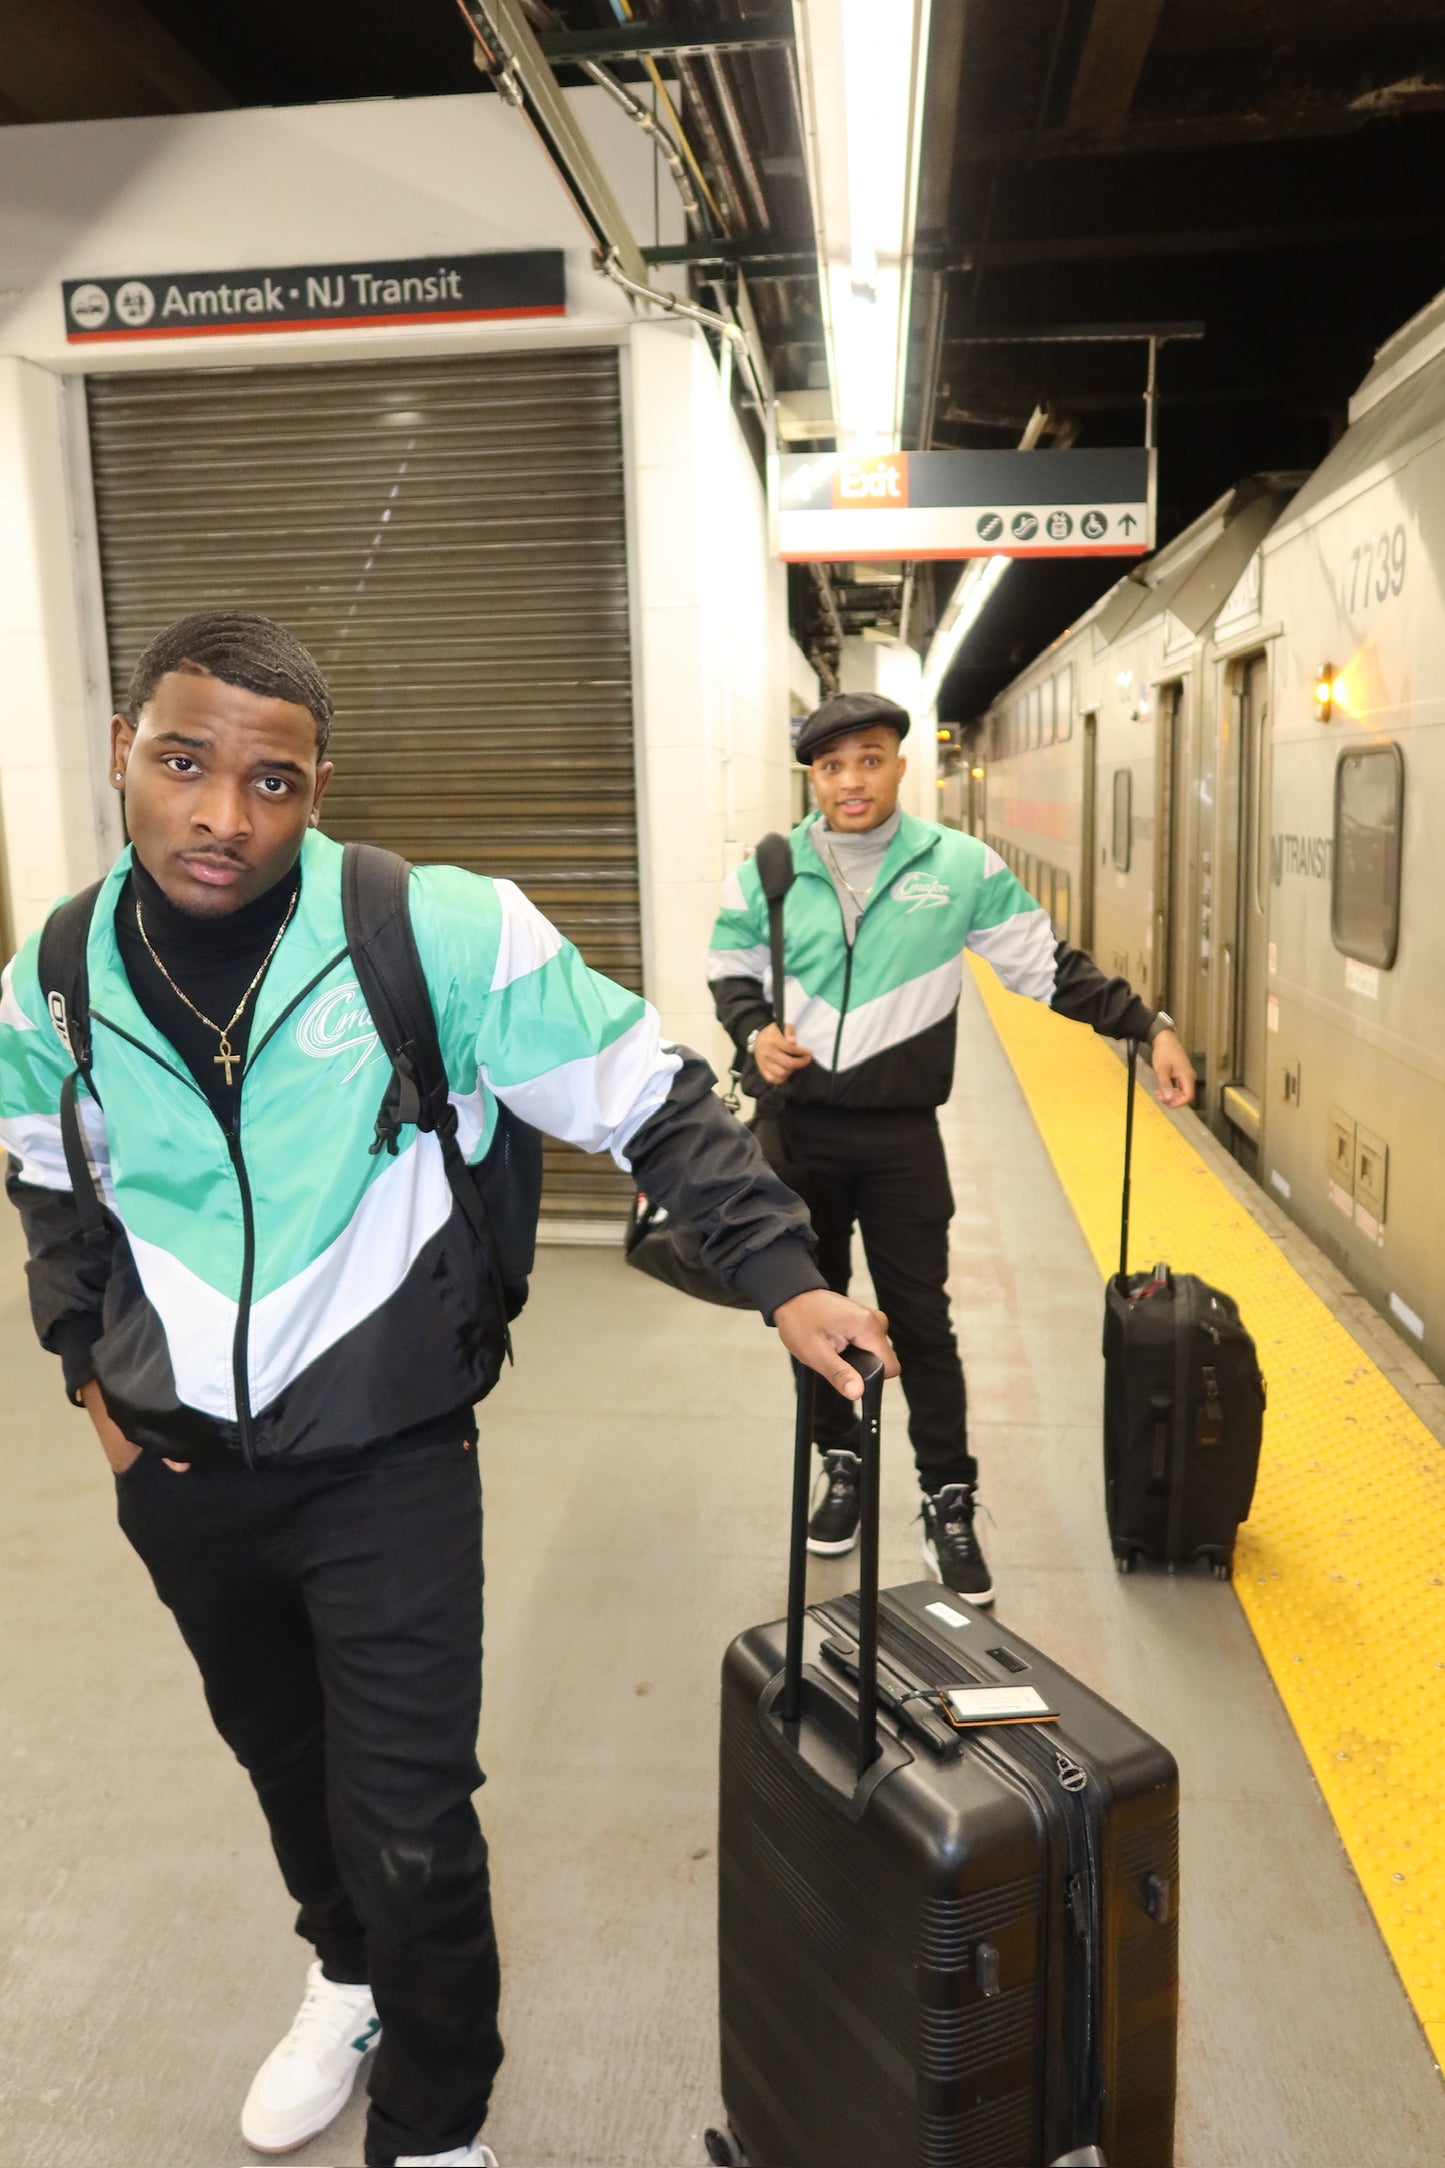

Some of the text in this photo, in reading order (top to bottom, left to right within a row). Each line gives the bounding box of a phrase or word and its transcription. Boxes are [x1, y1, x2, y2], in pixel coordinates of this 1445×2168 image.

[160, 267, 464, 319] Amtrak NJ Transit
[841, 462, 902, 497] Exit
[1349, 522, 1407, 614] 7739
